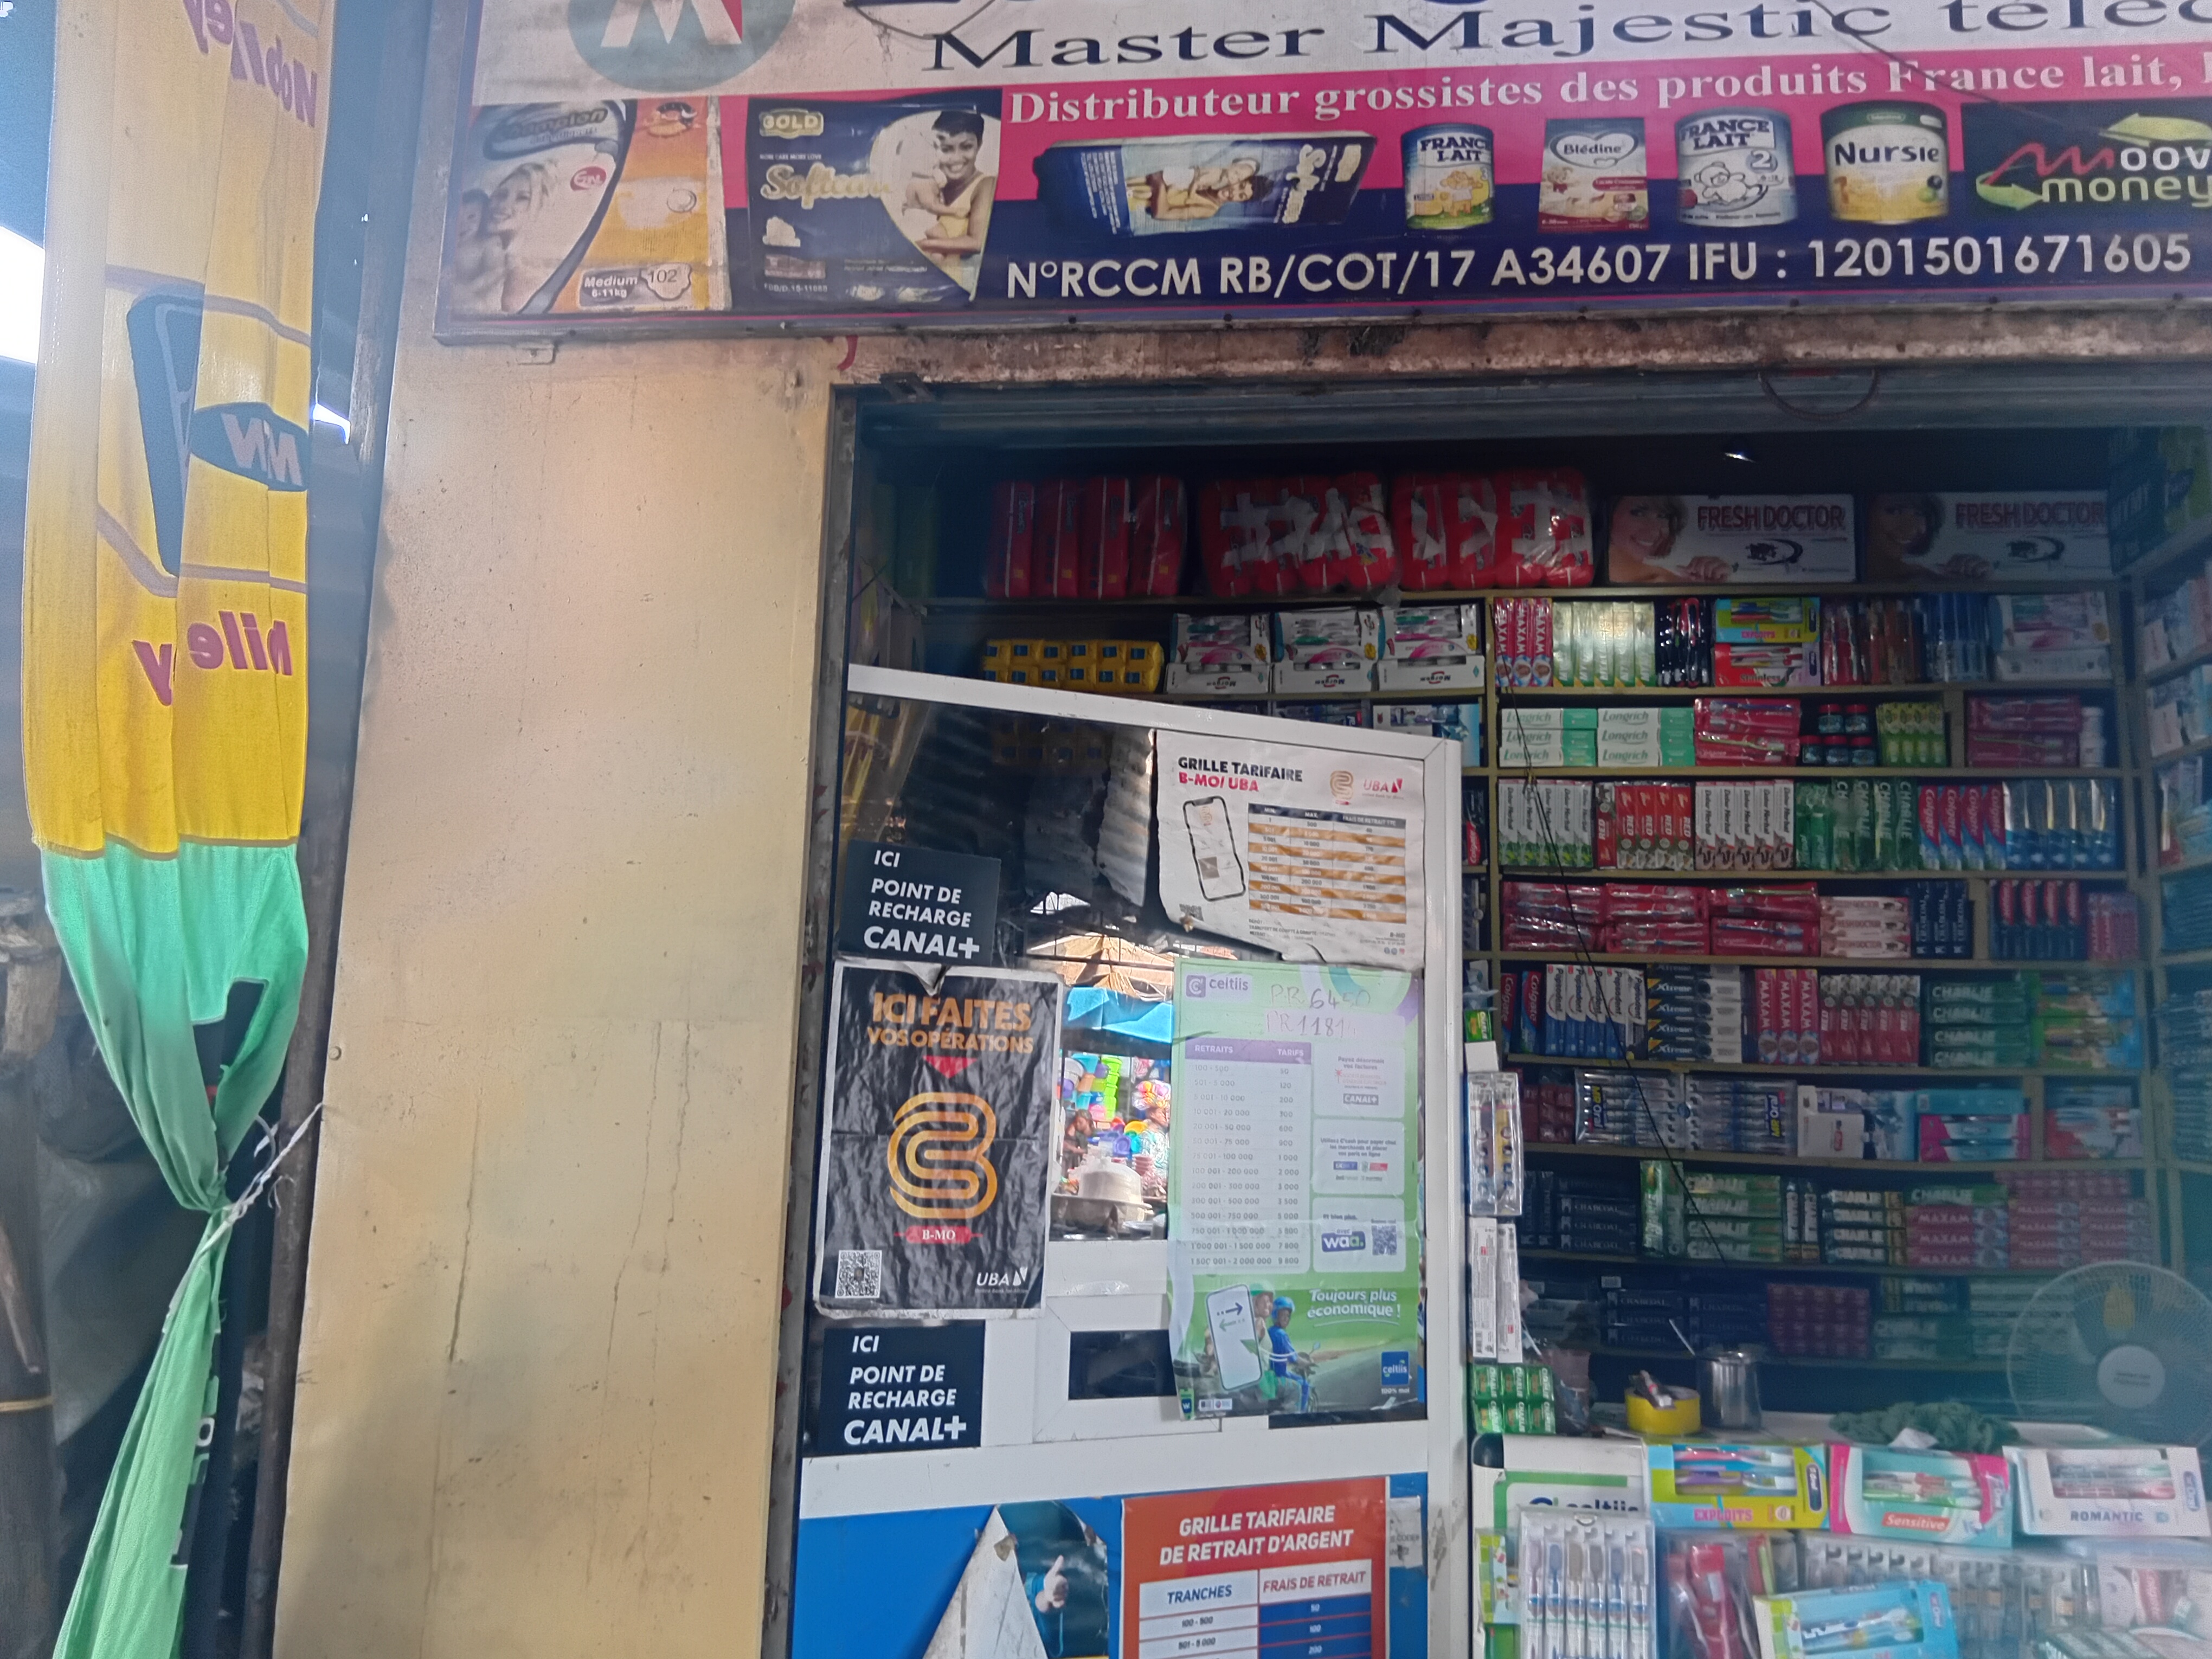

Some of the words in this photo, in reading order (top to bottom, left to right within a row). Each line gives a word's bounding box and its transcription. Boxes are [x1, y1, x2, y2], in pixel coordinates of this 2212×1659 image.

[921, 26, 1325, 71] Master
[1364, 4, 1893, 57] Majestic
[1009, 87, 1300, 124] Distributeur
[1315, 75, 1542, 121] grossistes
[1560, 71, 1638, 104] des
[1658, 63, 1868, 110] produits
[1886, 61, 2065, 92] France
[2083, 54, 2183, 92] lait,
[763, 115, 818, 129] GOLD
[1682, 119, 1770, 142] FRANCE
[1564, 143, 1621, 155] Blédine
[1693, 133, 1751, 150] LAIT
[1438, 150, 1482, 162] LAIT
[1750, 151, 1771, 168] 2
[1835, 142, 1939, 165] Nursie
[2042, 176, 2212, 207] money
[1008, 258, 1202, 299] N°RCCM
[1220, 249, 1476, 297] RB/COT/17
[1491, 243, 1671, 287] A34607
[1688, 241, 1757, 281] IFU
[1777, 248, 1786, 279] :
[1808, 235, 2191, 279] 1201501671605
[584, 275, 638, 286] Medium
[650, 270, 677, 283] 102
[1697, 505, 1760, 530] FRESH
[1764, 505, 1844, 529] DOCTOR
[1603, 710, 1648, 725] Longrich
[1602, 730, 1647, 744] Longrich
[1602, 749, 1648, 763] Longrich
[1179, 757, 1230, 774] GRILLE
[1233, 762, 1303, 782] TARIFAIRE
[1229, 776, 1259, 792] UBA
[1364, 779, 1388, 792] UBA
[1924, 789, 1935, 841] Colgate
[1947, 789, 1958, 840] Colgate
[874, 850, 900, 867] ICI
[871, 878, 934, 901] POINT
[937, 887, 961, 904] DE
[869, 901, 972, 928] RECHARGE
[864, 926, 980, 959] CANAL+
[1209, 978, 1248, 991] celtiis
[1657, 983, 1692, 993] Xtreme
[1530, 974, 1539, 1021] Colgate
[1759, 980, 1770, 1028] MAXAM
[1780, 980, 1790, 1028] MAXAM
[1802, 981, 1812, 1029] MAXAM
[872, 992, 916, 1025] ICI
[921, 996, 1032, 1031] FAITES
[1657, 1004, 1692, 1014] Xtreme
[1657, 1025, 1692, 1034] Xtreme
[868, 1026, 908, 1046] VOS
[911, 1028, 1033, 1054] OPÉRATIONS
[1195, 1045, 1233, 1053] RETRAITS
[1278, 1049, 1304, 1057] TARIFS
[1658, 1045, 1692, 1054] Xtreme
[1920, 1213, 1970, 1224] MAXAM
[922, 1229, 956, 1241] B-MO
[1920, 1233, 1970, 1244] MAXAM
[1920, 1255, 1970, 1265] MAXAM
[977, 1272, 1009, 1286] UBA
[1309, 1289, 1366, 1303] Toujours
[1370, 1288, 1397, 1303] plus
[1307, 1304, 1393, 1319] économique
[1396, 1305, 1400, 1318] !
[852, 1335, 879, 1353] ICI
[850, 1365, 916, 1385] POINT
[920, 1365, 946, 1382] DE
[1382, 1364, 1407, 1374] celtiis
[848, 1388, 956, 1410] RECHARGE
[844, 1415, 967, 1445] CANAL+
[1180, 1513, 1242, 1536] GRILLE
[1246, 1505, 1335, 1528] TARIFAIRE
[1694, 1508, 1752, 1521] EXPLOITS
[1886, 1514, 1946, 1529] Sensitive
[2070, 1510, 2143, 1522] ROMANTIC
[1160, 1546, 1185, 1566] DE
[1188, 1536, 1265, 1562] RETRAIT
[1268, 1529, 1354, 1553] D'ARGENT
[1167, 1585, 1232, 1604] TRANCHES
[1263, 1577, 1297, 1593] FRAIS
[1300, 1576, 1315, 1589] DE
[1317, 1572, 1366, 1587] RETRAIT
